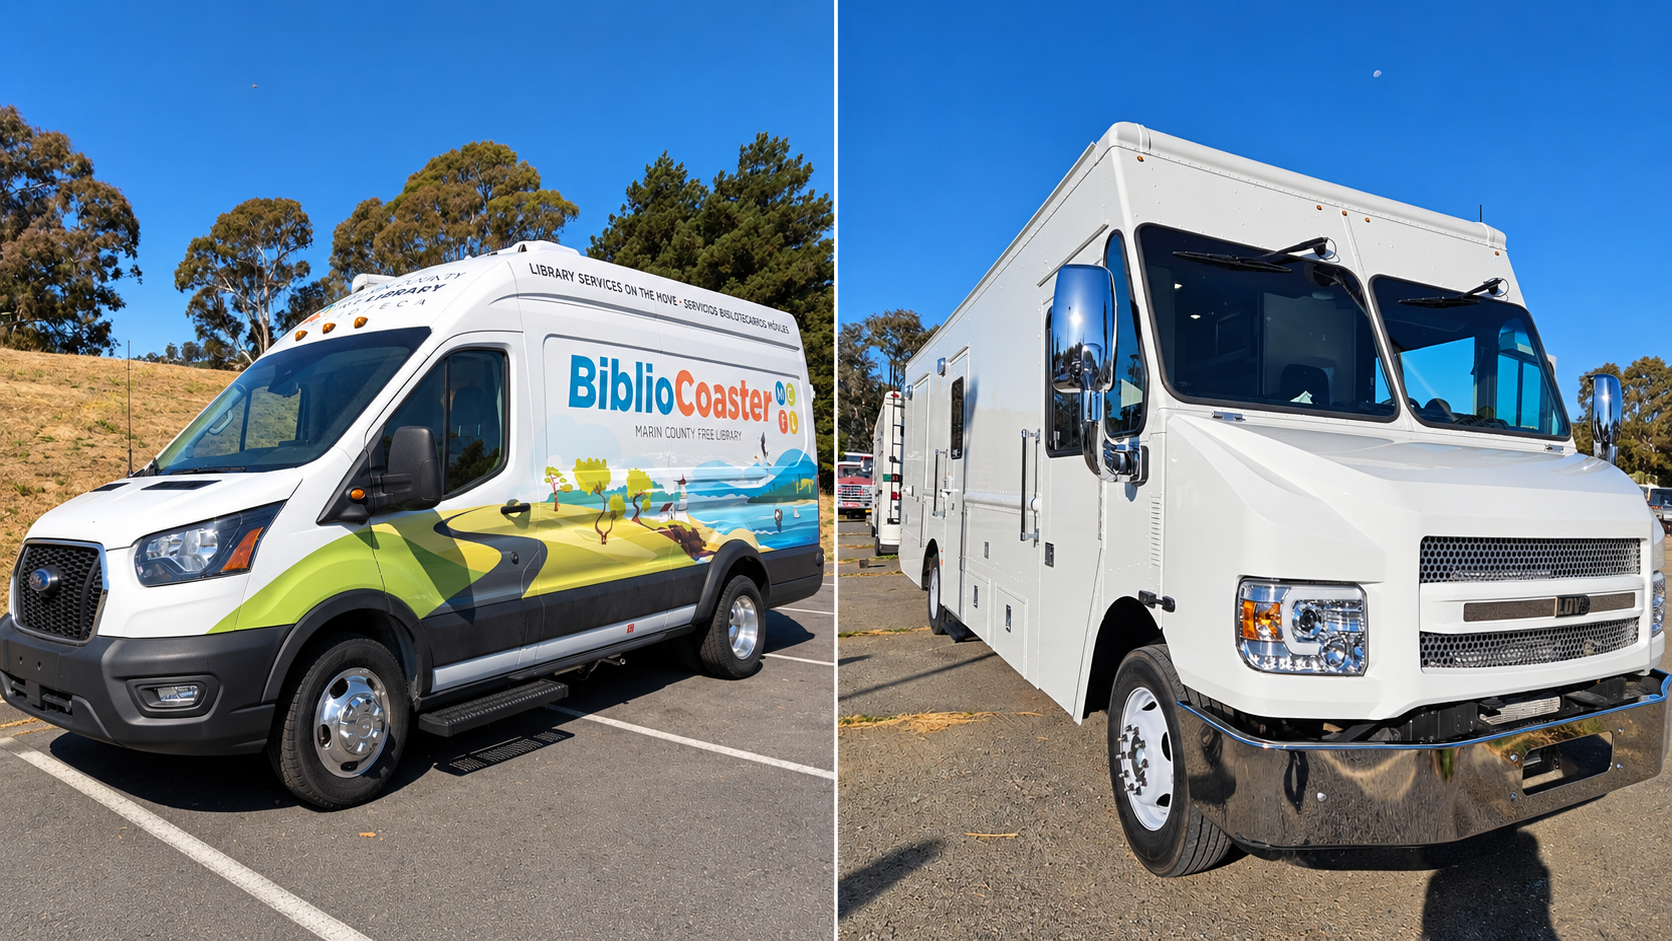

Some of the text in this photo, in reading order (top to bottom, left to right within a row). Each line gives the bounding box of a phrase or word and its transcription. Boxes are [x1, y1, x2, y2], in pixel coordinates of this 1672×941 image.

[365, 283, 447, 303] LIBRARY
[529, 262, 575, 282] LIBRARY
[578, 273, 623, 293] SERVICES
[624, 284, 638, 297] ON
[639, 287, 655, 301] THE
[656, 291, 678, 306] MOVE
[568, 354, 773, 422] BiblioCoaster
[635, 425, 743, 441] MARIN COUNTY FREE LIBRARY
